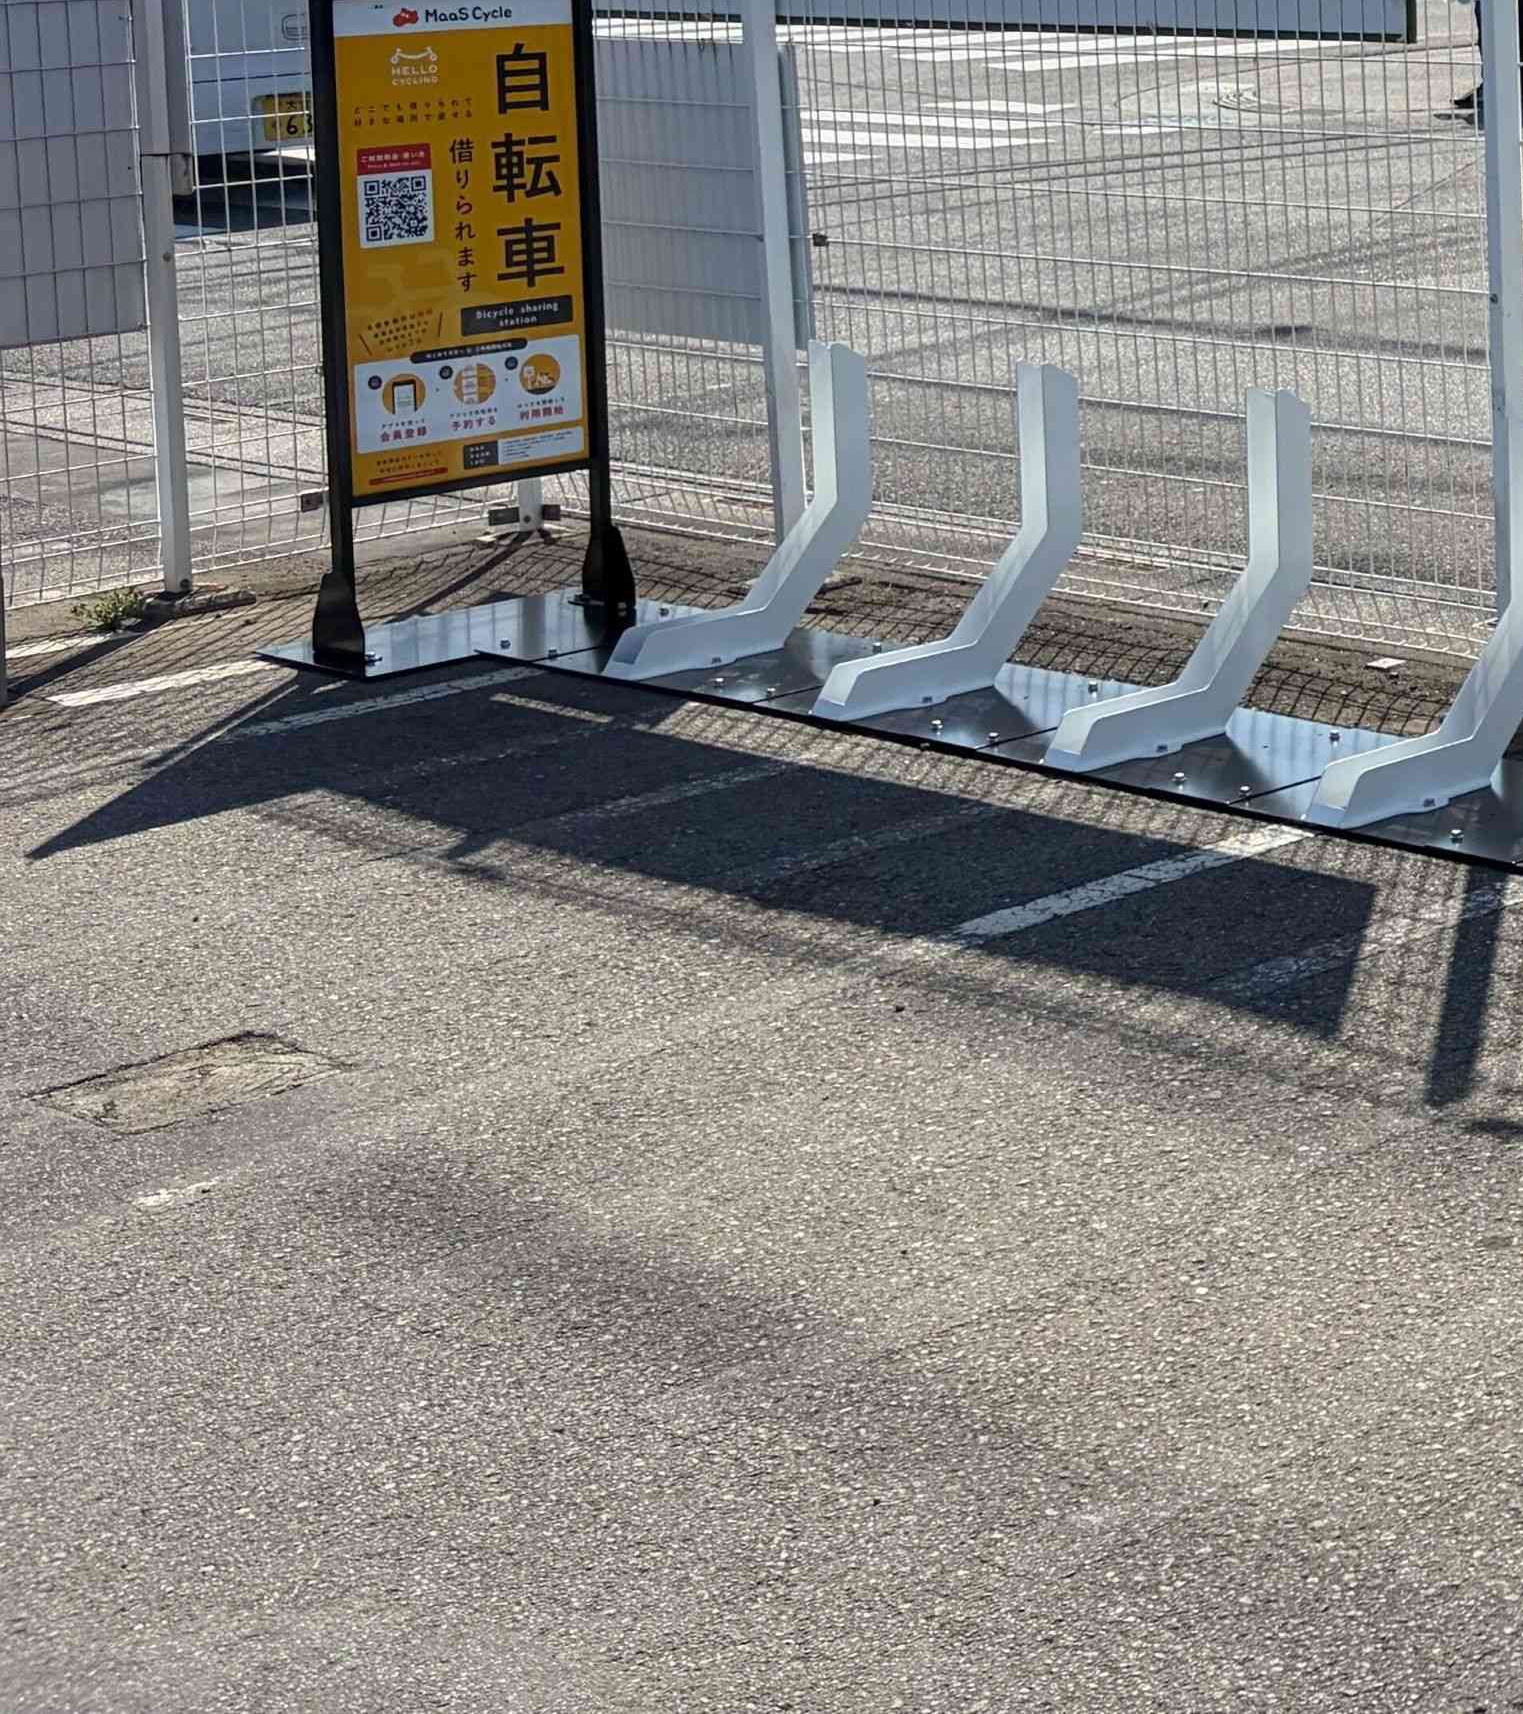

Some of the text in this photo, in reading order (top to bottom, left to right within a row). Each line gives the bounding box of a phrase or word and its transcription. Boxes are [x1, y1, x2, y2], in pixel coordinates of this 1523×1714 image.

[425, 5, 513, 24] MaaS Cycle
[391, 64, 439, 76] HELLO
[391, 76, 439, 86] CYCLING
[491, 42, 565, 288] 自転車
[449, 138, 476, 292] 借りられます
[475, 300, 560, 320] Bicycle sharing
[499, 314, 537, 328] station
[451, 417, 497, 432] 予約する
